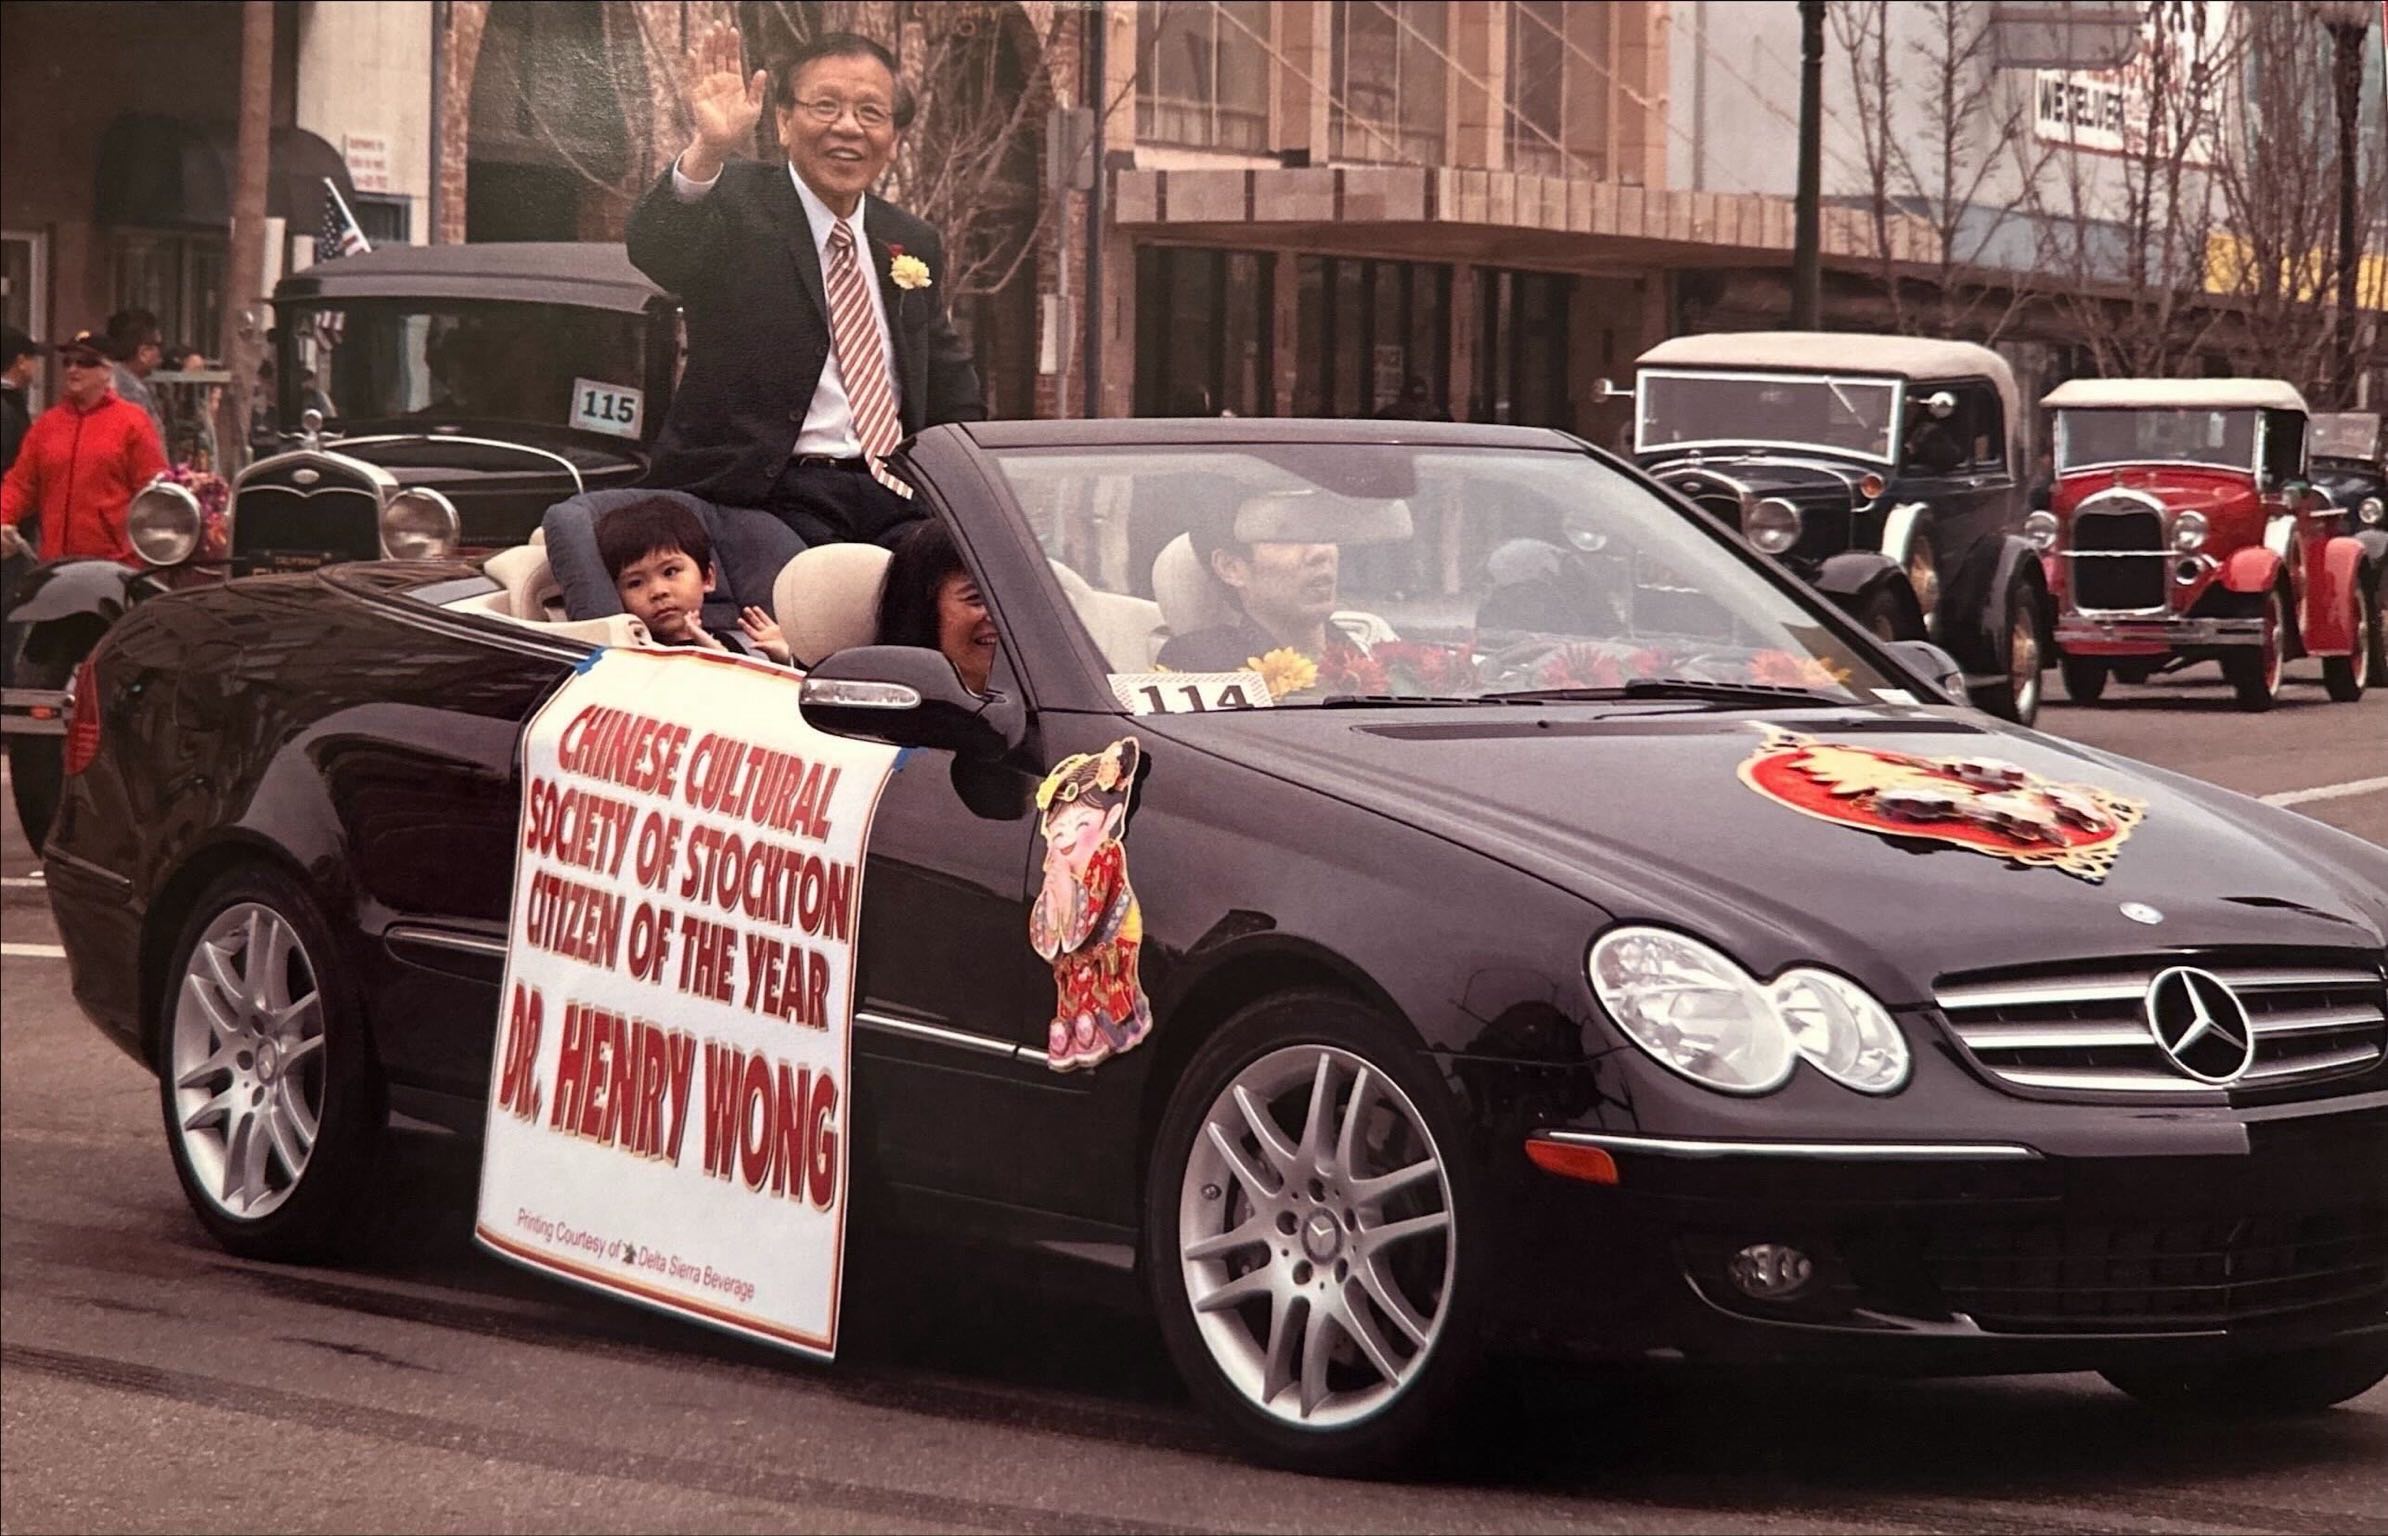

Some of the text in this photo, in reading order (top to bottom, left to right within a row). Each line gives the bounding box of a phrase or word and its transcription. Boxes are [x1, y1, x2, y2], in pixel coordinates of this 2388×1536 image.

[582, 390, 635, 423] 115
[1139, 685, 1254, 714] 114
[558, 704, 841, 844] CHINESE CULTURAL
[526, 778, 855, 943] SOCIETY OF STOCKTON
[526, 871, 830, 1032] CITIZEN OF THE YEAR
[499, 977, 840, 1213] DR. HENRY WONG
[517, 1207, 755, 1302] Printing Courtesy of Delta Sierra Beverage
